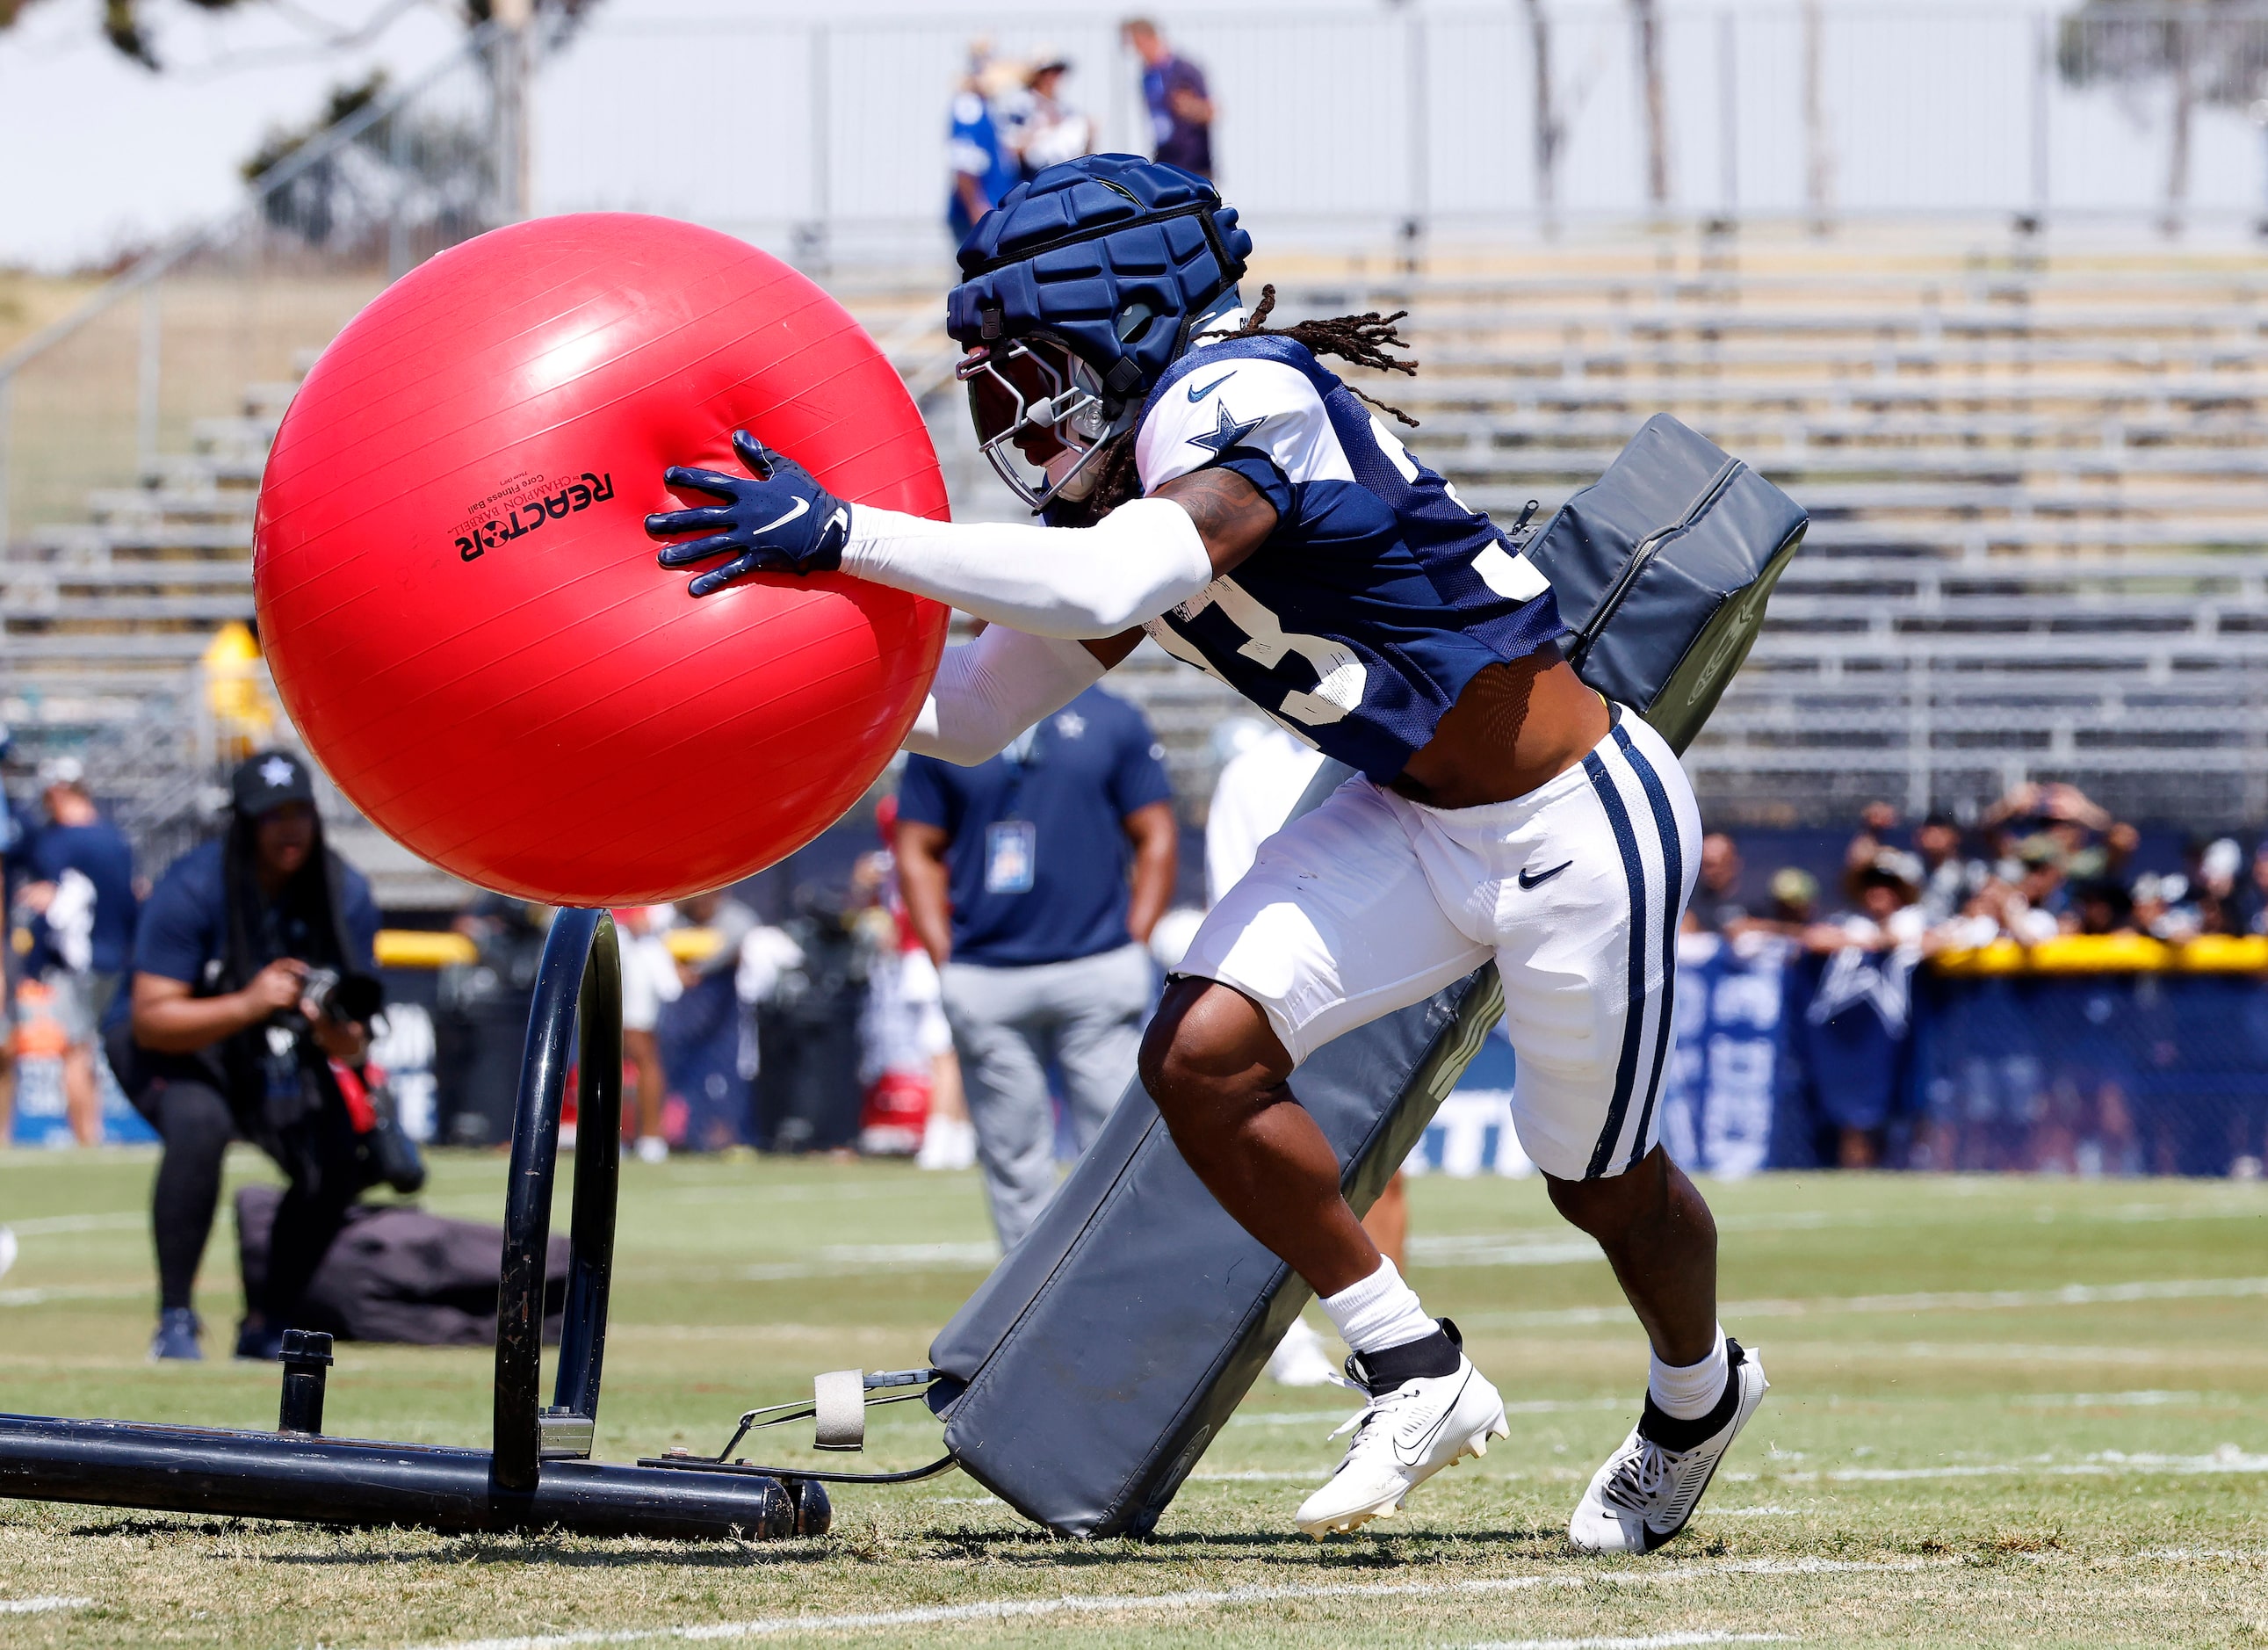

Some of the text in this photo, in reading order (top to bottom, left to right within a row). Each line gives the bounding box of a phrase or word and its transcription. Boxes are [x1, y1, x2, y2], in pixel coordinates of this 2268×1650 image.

[467, 474, 545, 515] Core Fitness Ball
[503, 475, 572, 511] CHAMPION
[454, 472, 615, 562] REACTOR
